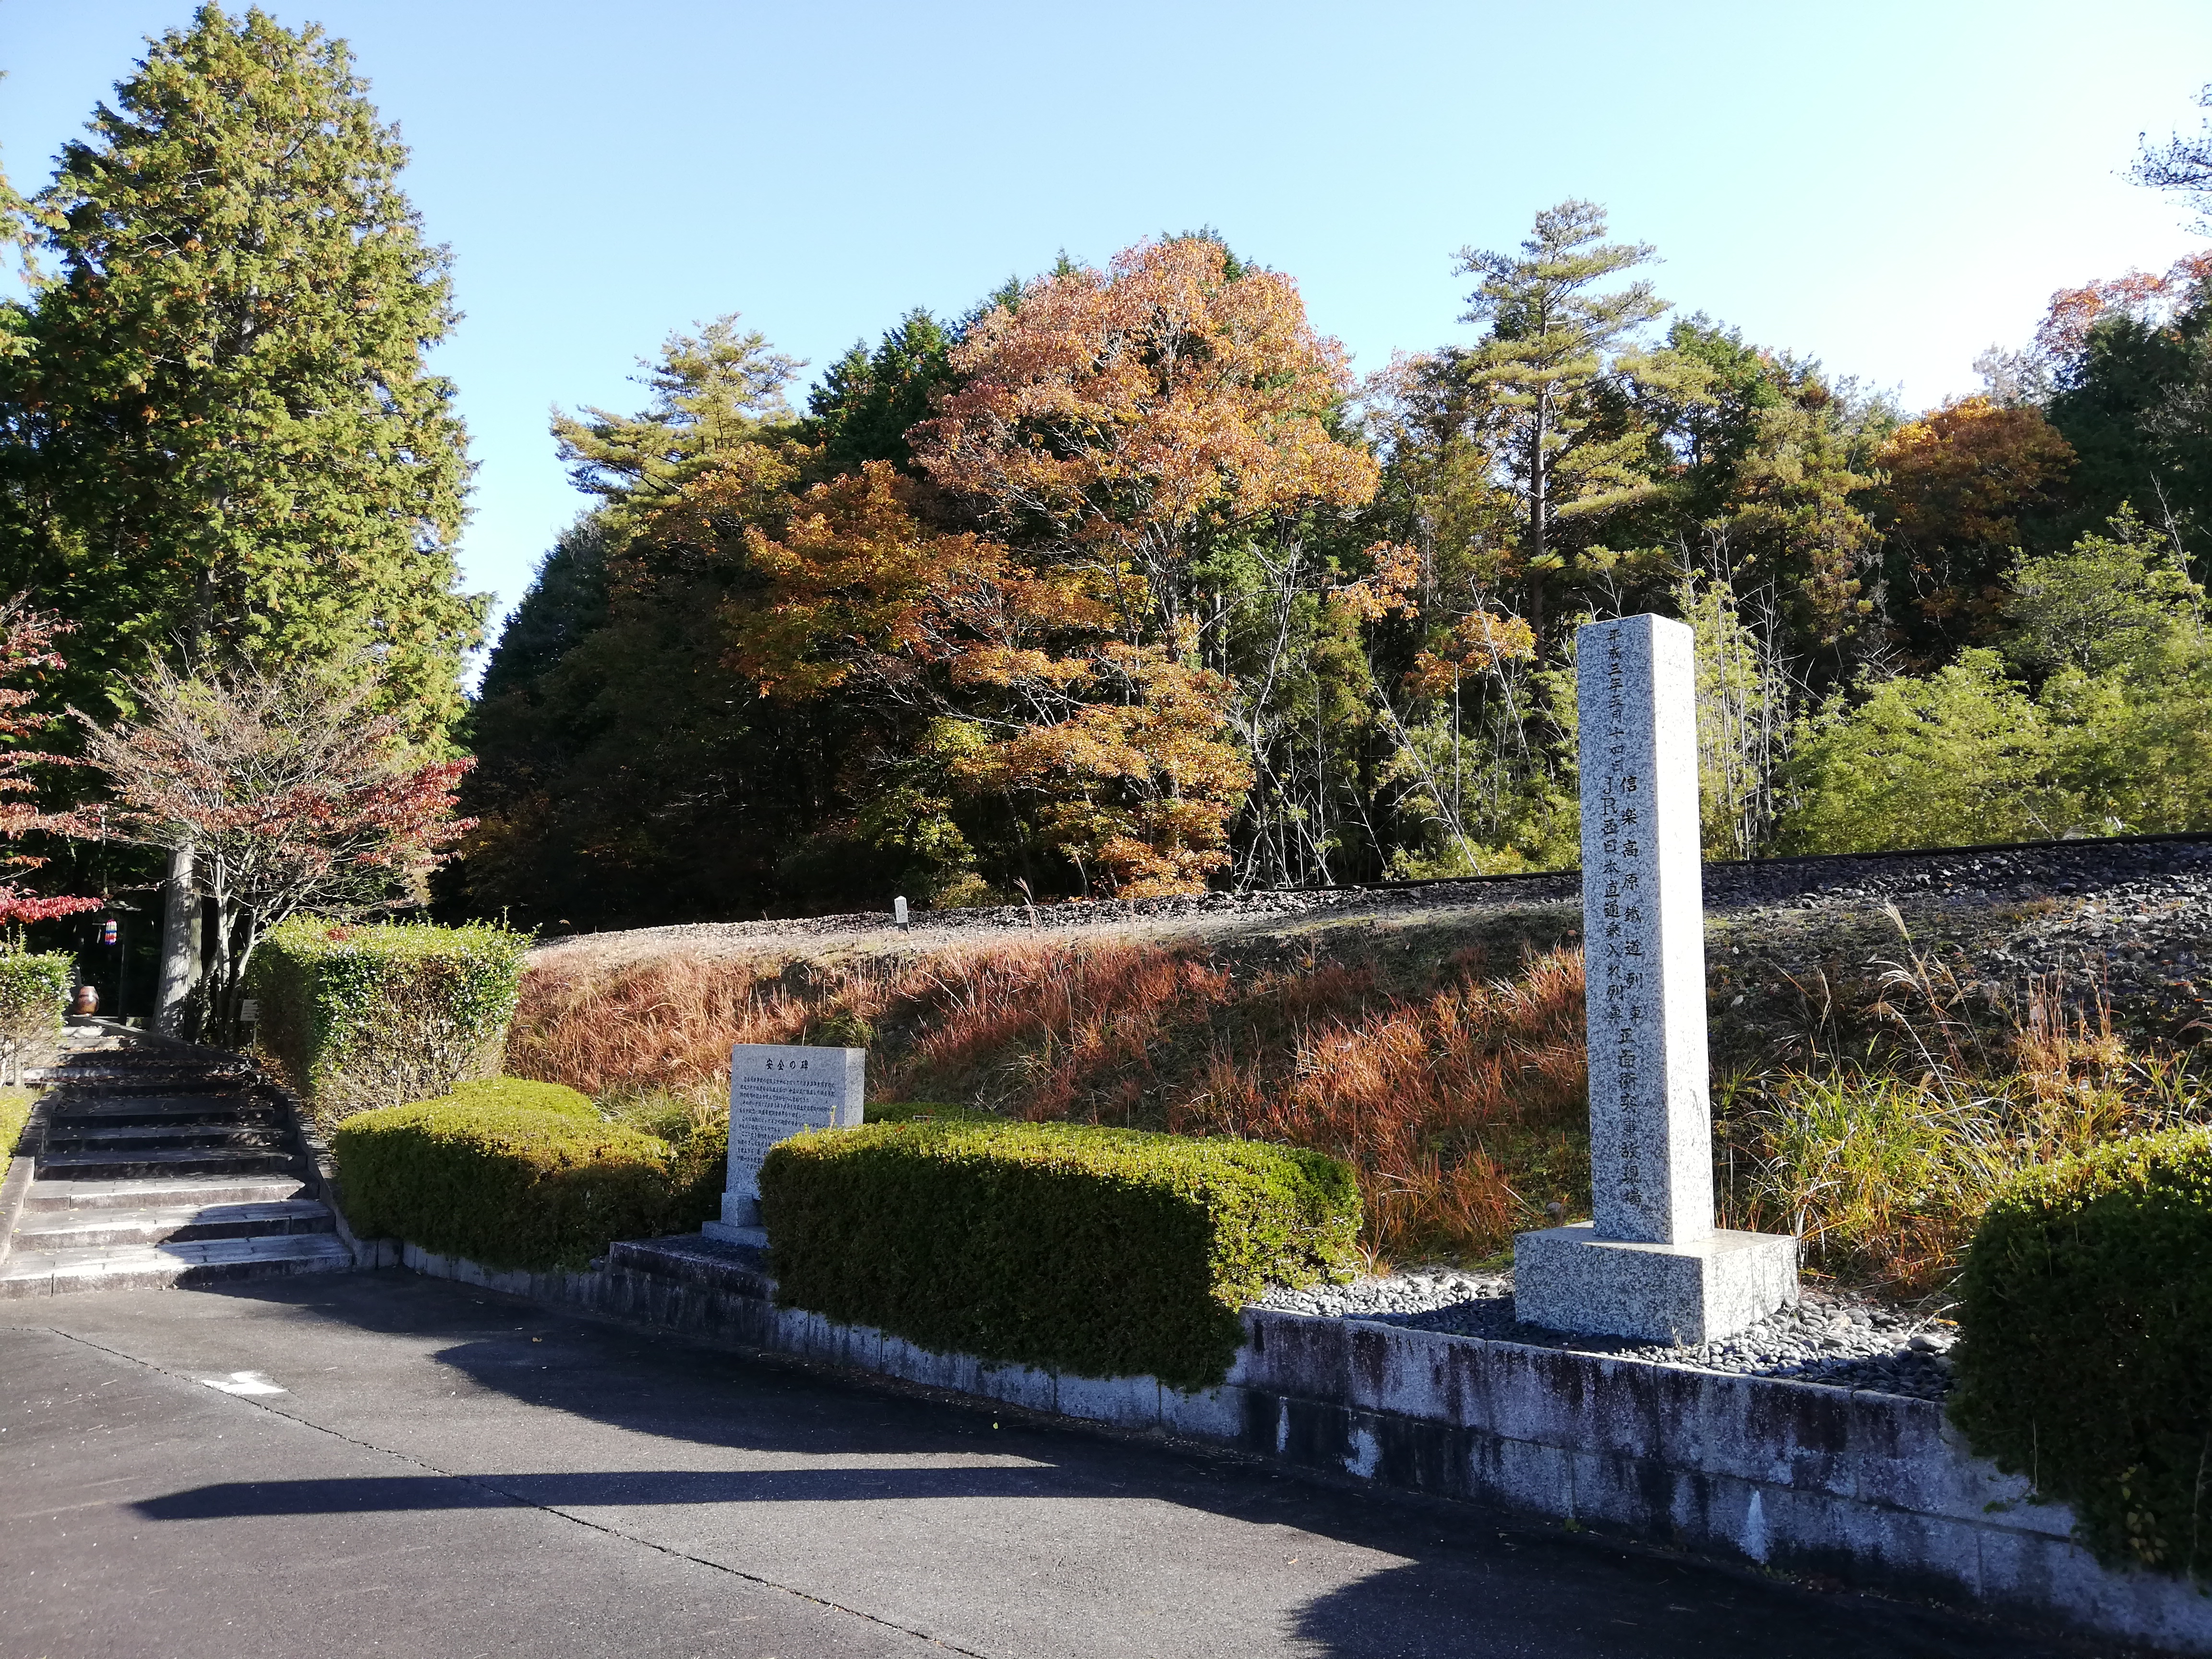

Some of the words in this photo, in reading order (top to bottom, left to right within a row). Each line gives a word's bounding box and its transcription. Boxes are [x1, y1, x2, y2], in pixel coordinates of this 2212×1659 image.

[1607, 628, 1625, 772] 平成三年五月十四日
[765, 1058, 808, 1071] 安全の碑
[1617, 1027, 1643, 1205] 正面衝突事故現場
